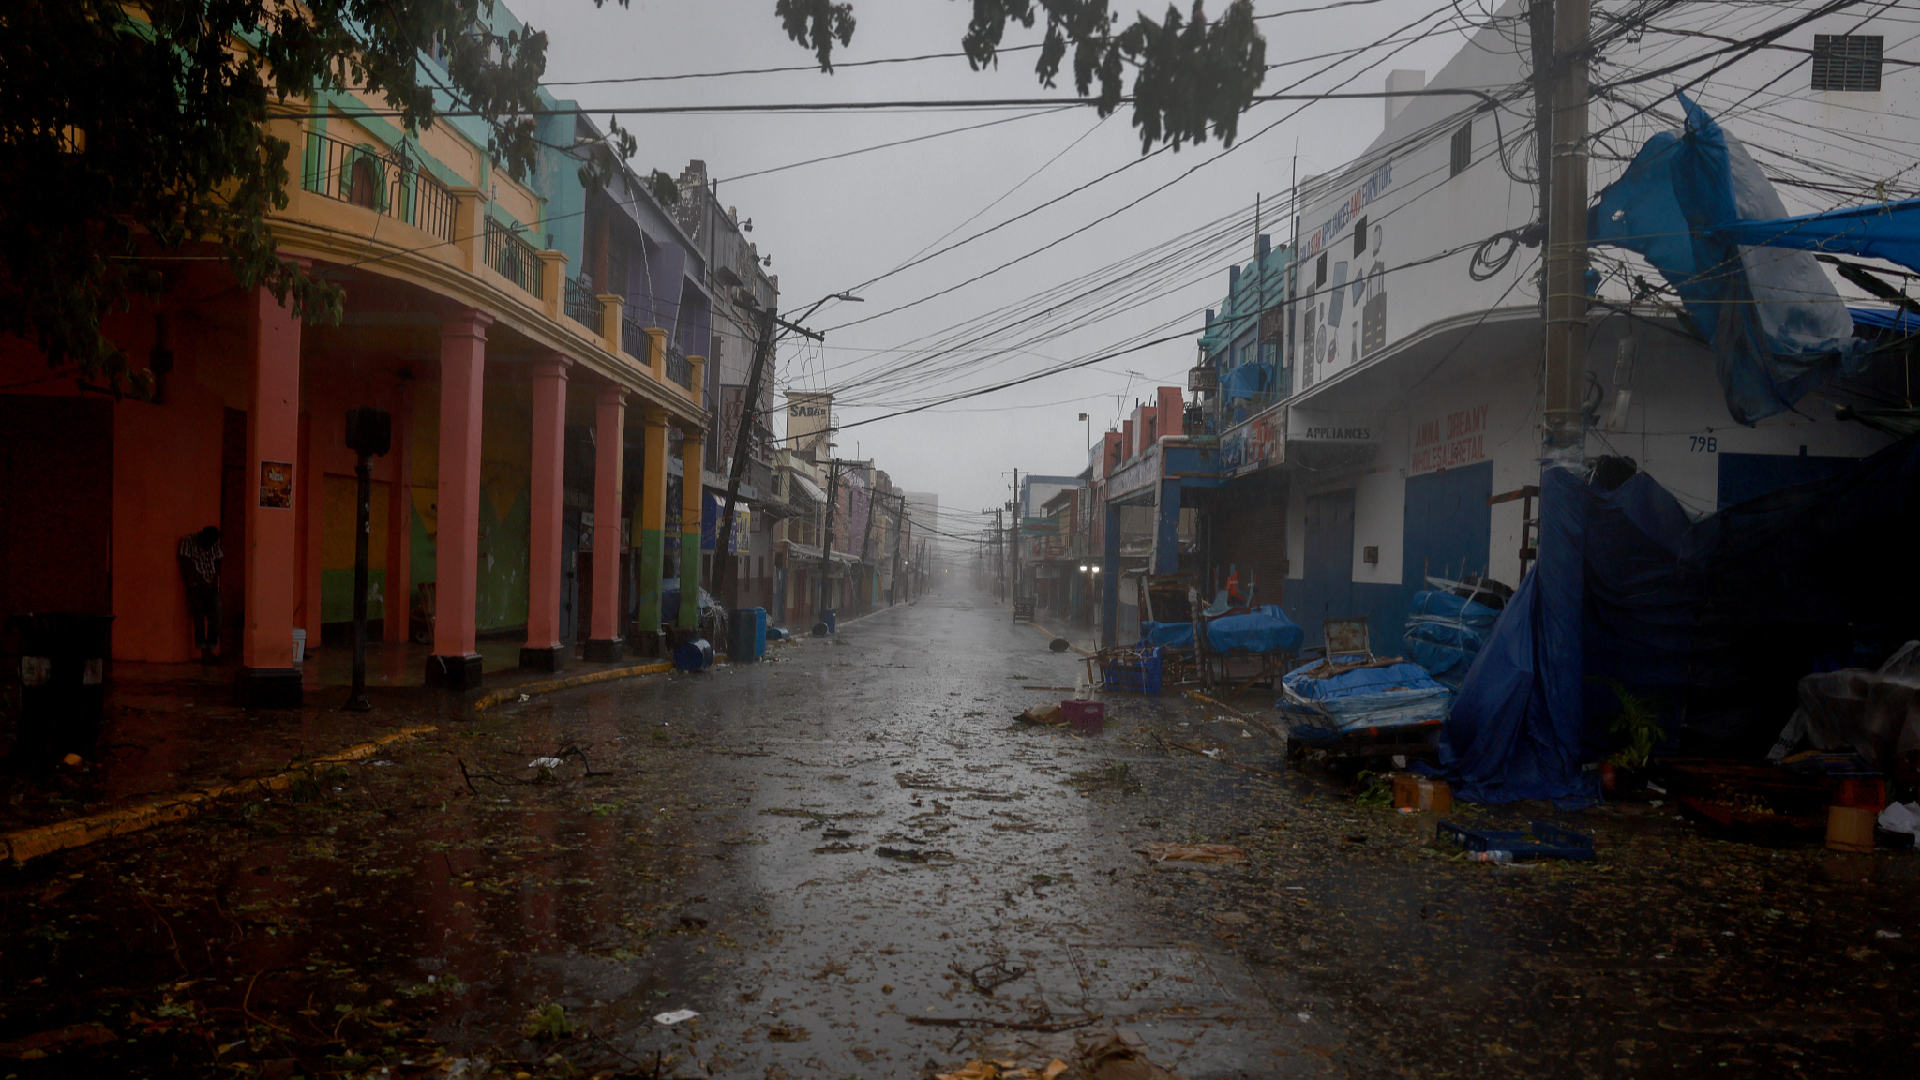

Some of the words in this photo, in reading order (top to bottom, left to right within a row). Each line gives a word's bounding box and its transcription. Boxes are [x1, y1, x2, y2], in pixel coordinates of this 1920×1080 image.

[1311, 230, 1321, 258] STAR
[1321, 200, 1350, 248] APPLIANCES
[1350, 188, 1361, 221] AND
[1306, 427, 1371, 439] APPLIANCES
[1415, 418, 1440, 449] ANNA
[1447, 403, 1489, 440] DREAMY
[1689, 436, 1717, 453] 79B
